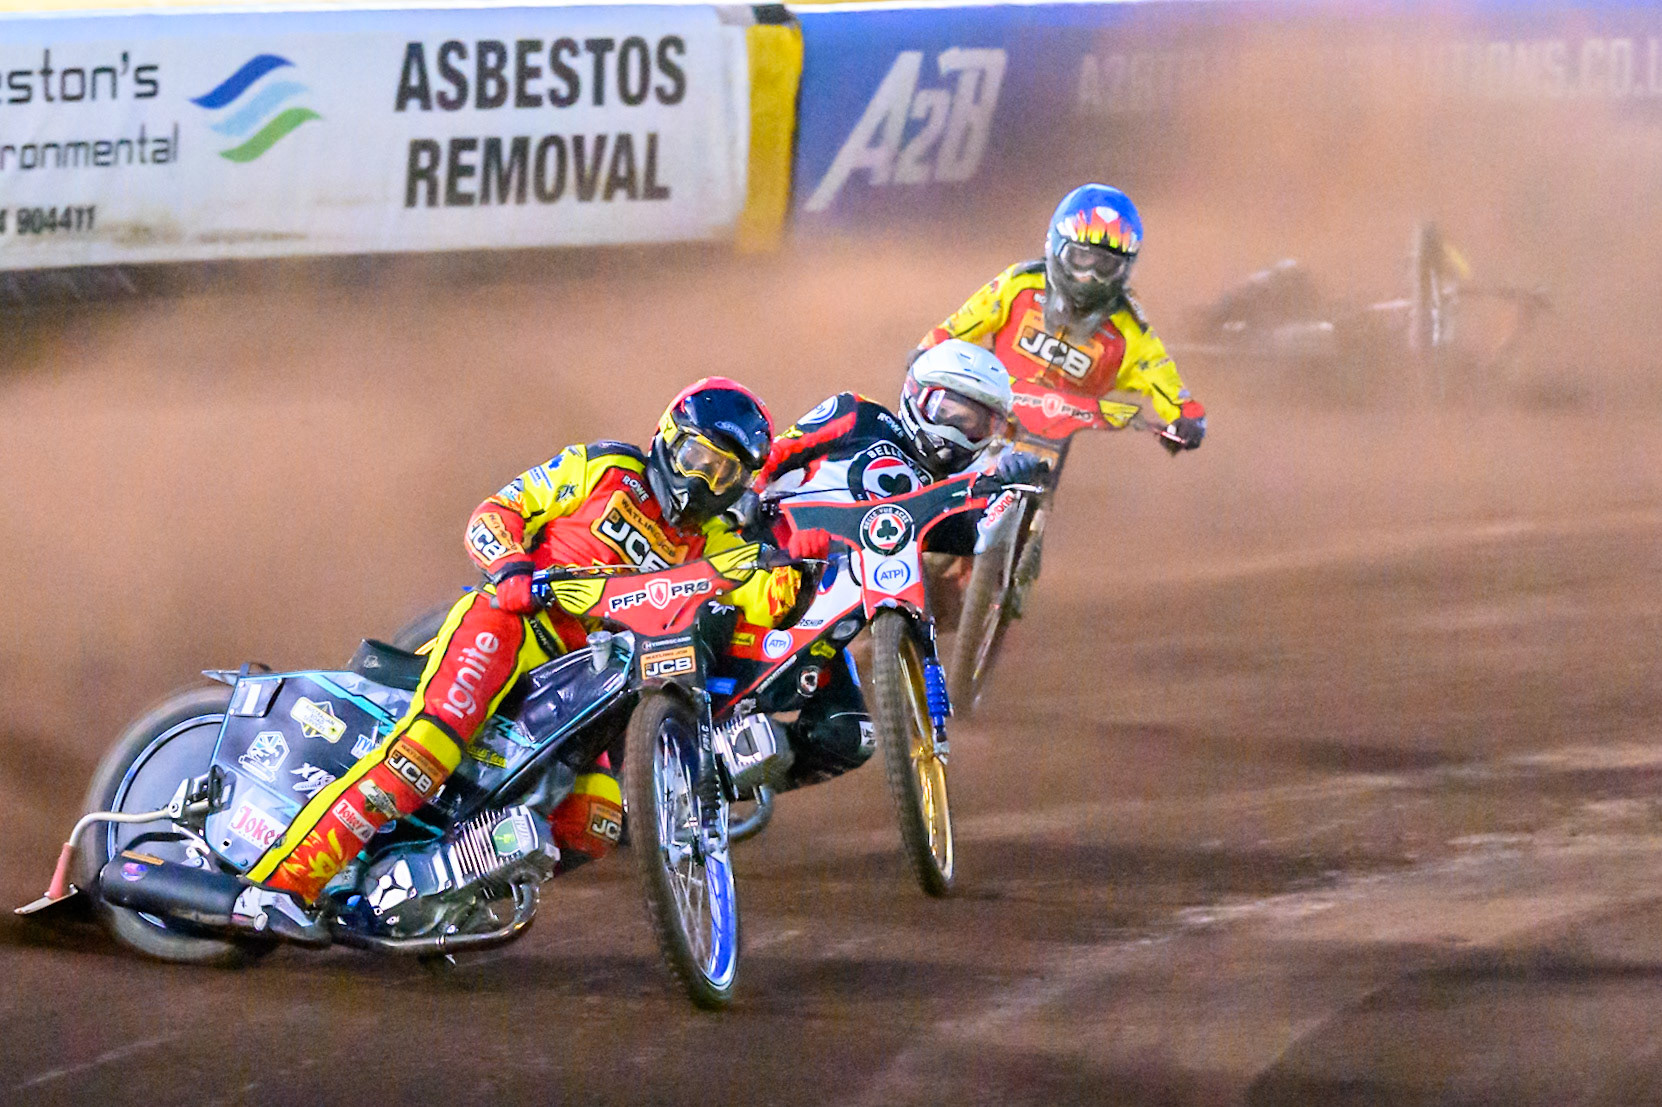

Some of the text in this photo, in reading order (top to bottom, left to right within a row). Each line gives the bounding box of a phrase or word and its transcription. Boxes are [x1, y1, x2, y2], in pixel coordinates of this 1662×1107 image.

[0, 48, 159, 104] ston's
[394, 34, 687, 112] ASBESTOS
[803, 46, 1008, 212] A2B
[404, 131, 671, 208] REMOVAL
[16, 204, 96, 235] 904411
[1019, 331, 1092, 378] JCB
[867, 445, 903, 459] BELLE
[622, 474, 650, 503] ROWE
[470, 522, 507, 561] JCB
[601, 519, 671, 573] JCB
[880, 568, 904, 581] ATPI
[611, 581, 709, 609] PFP PRO
[768, 639, 787, 649] ATPI
[645, 657, 693, 676] JCB
[388, 755, 433, 793] JCB
[231, 805, 281, 845] Joke
[592, 818, 621, 842] JC
